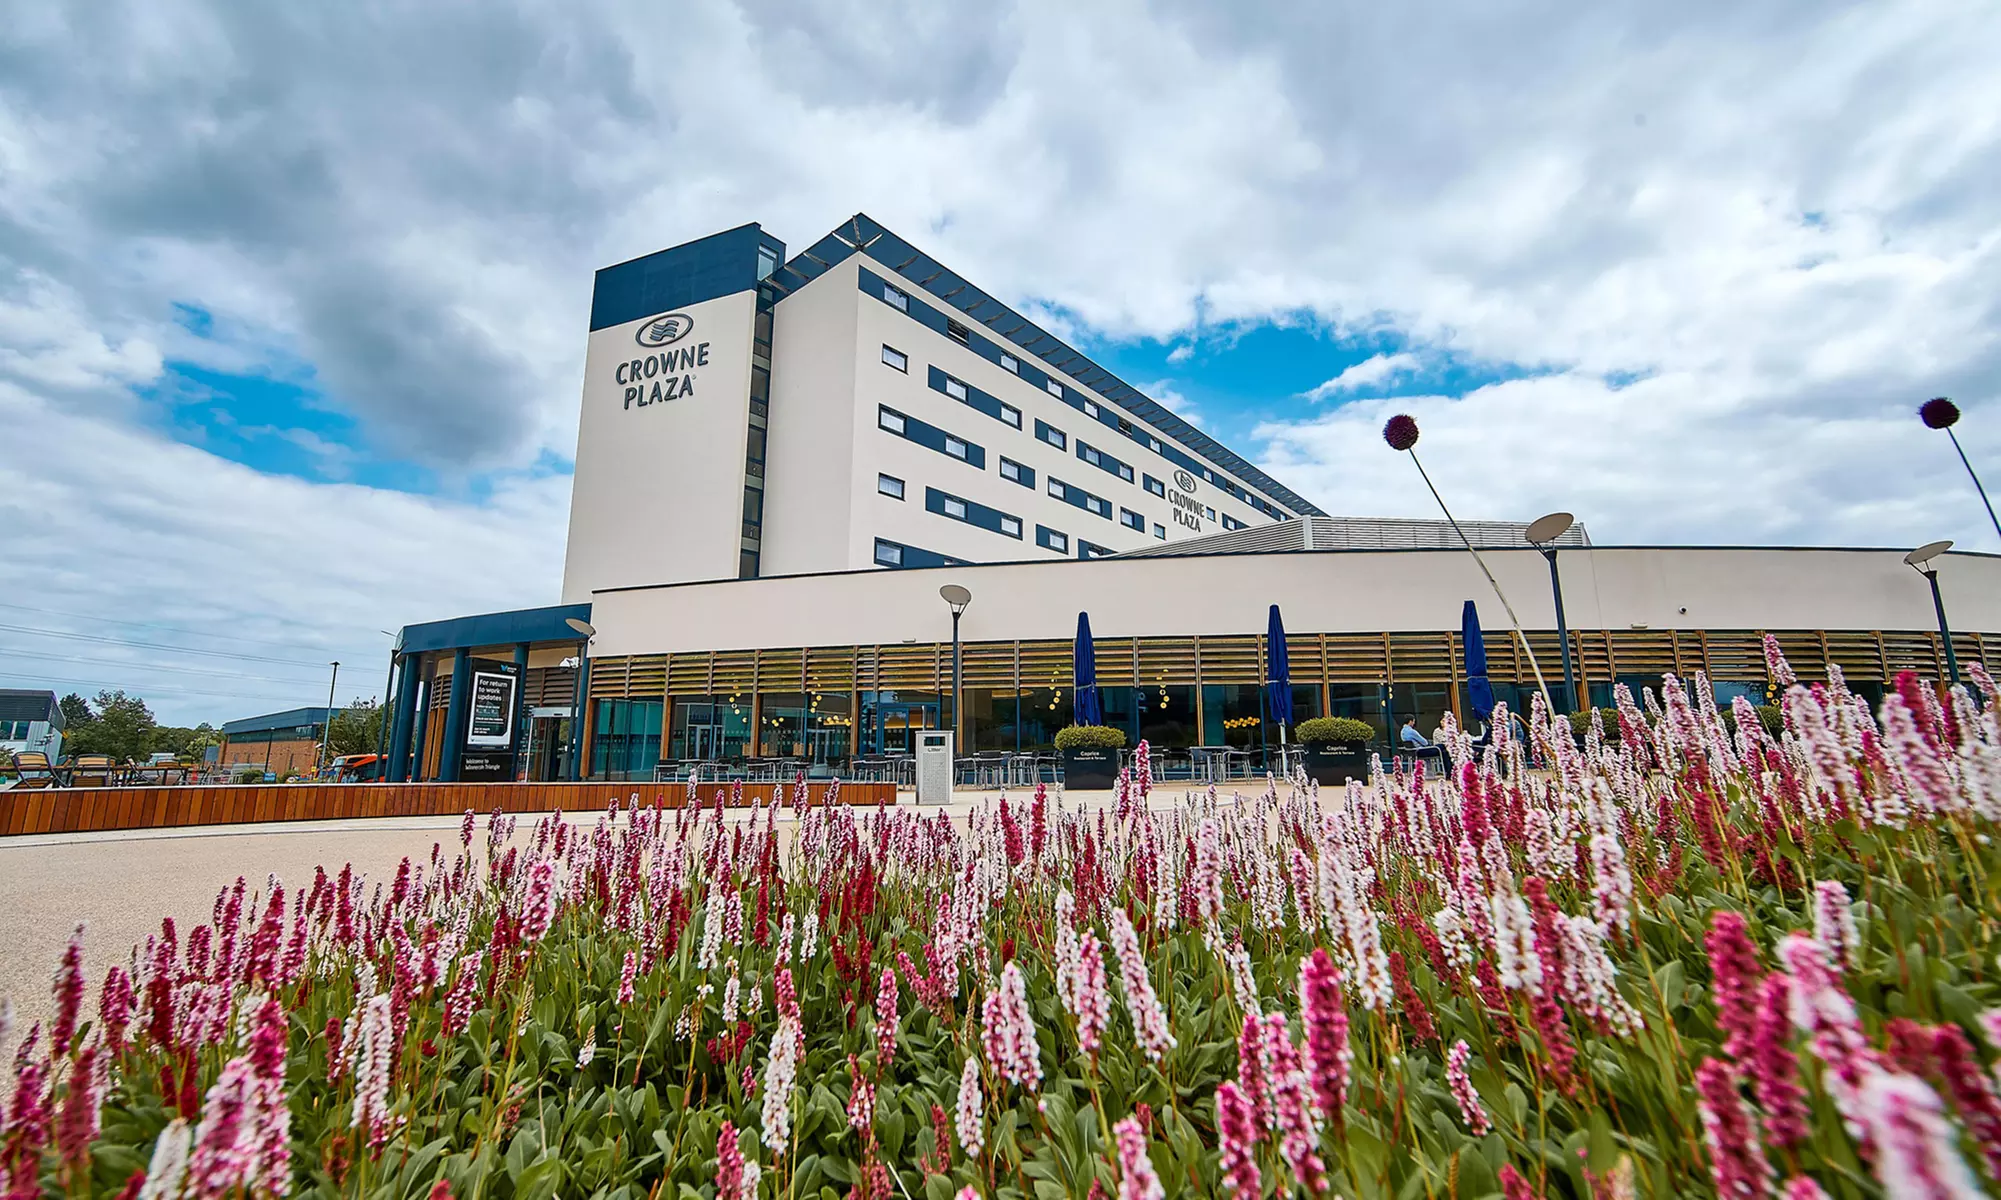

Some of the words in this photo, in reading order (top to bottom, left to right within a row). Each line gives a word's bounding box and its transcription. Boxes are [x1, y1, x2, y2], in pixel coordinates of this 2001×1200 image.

[616, 342, 710, 385] CROWNE
[624, 374, 693, 410] PLAZA
[1168, 488, 1205, 518] CROWNE
[1173, 507, 1201, 532] PLAZA
[490, 680, 508, 688] return
[477, 694, 502, 702] updates
